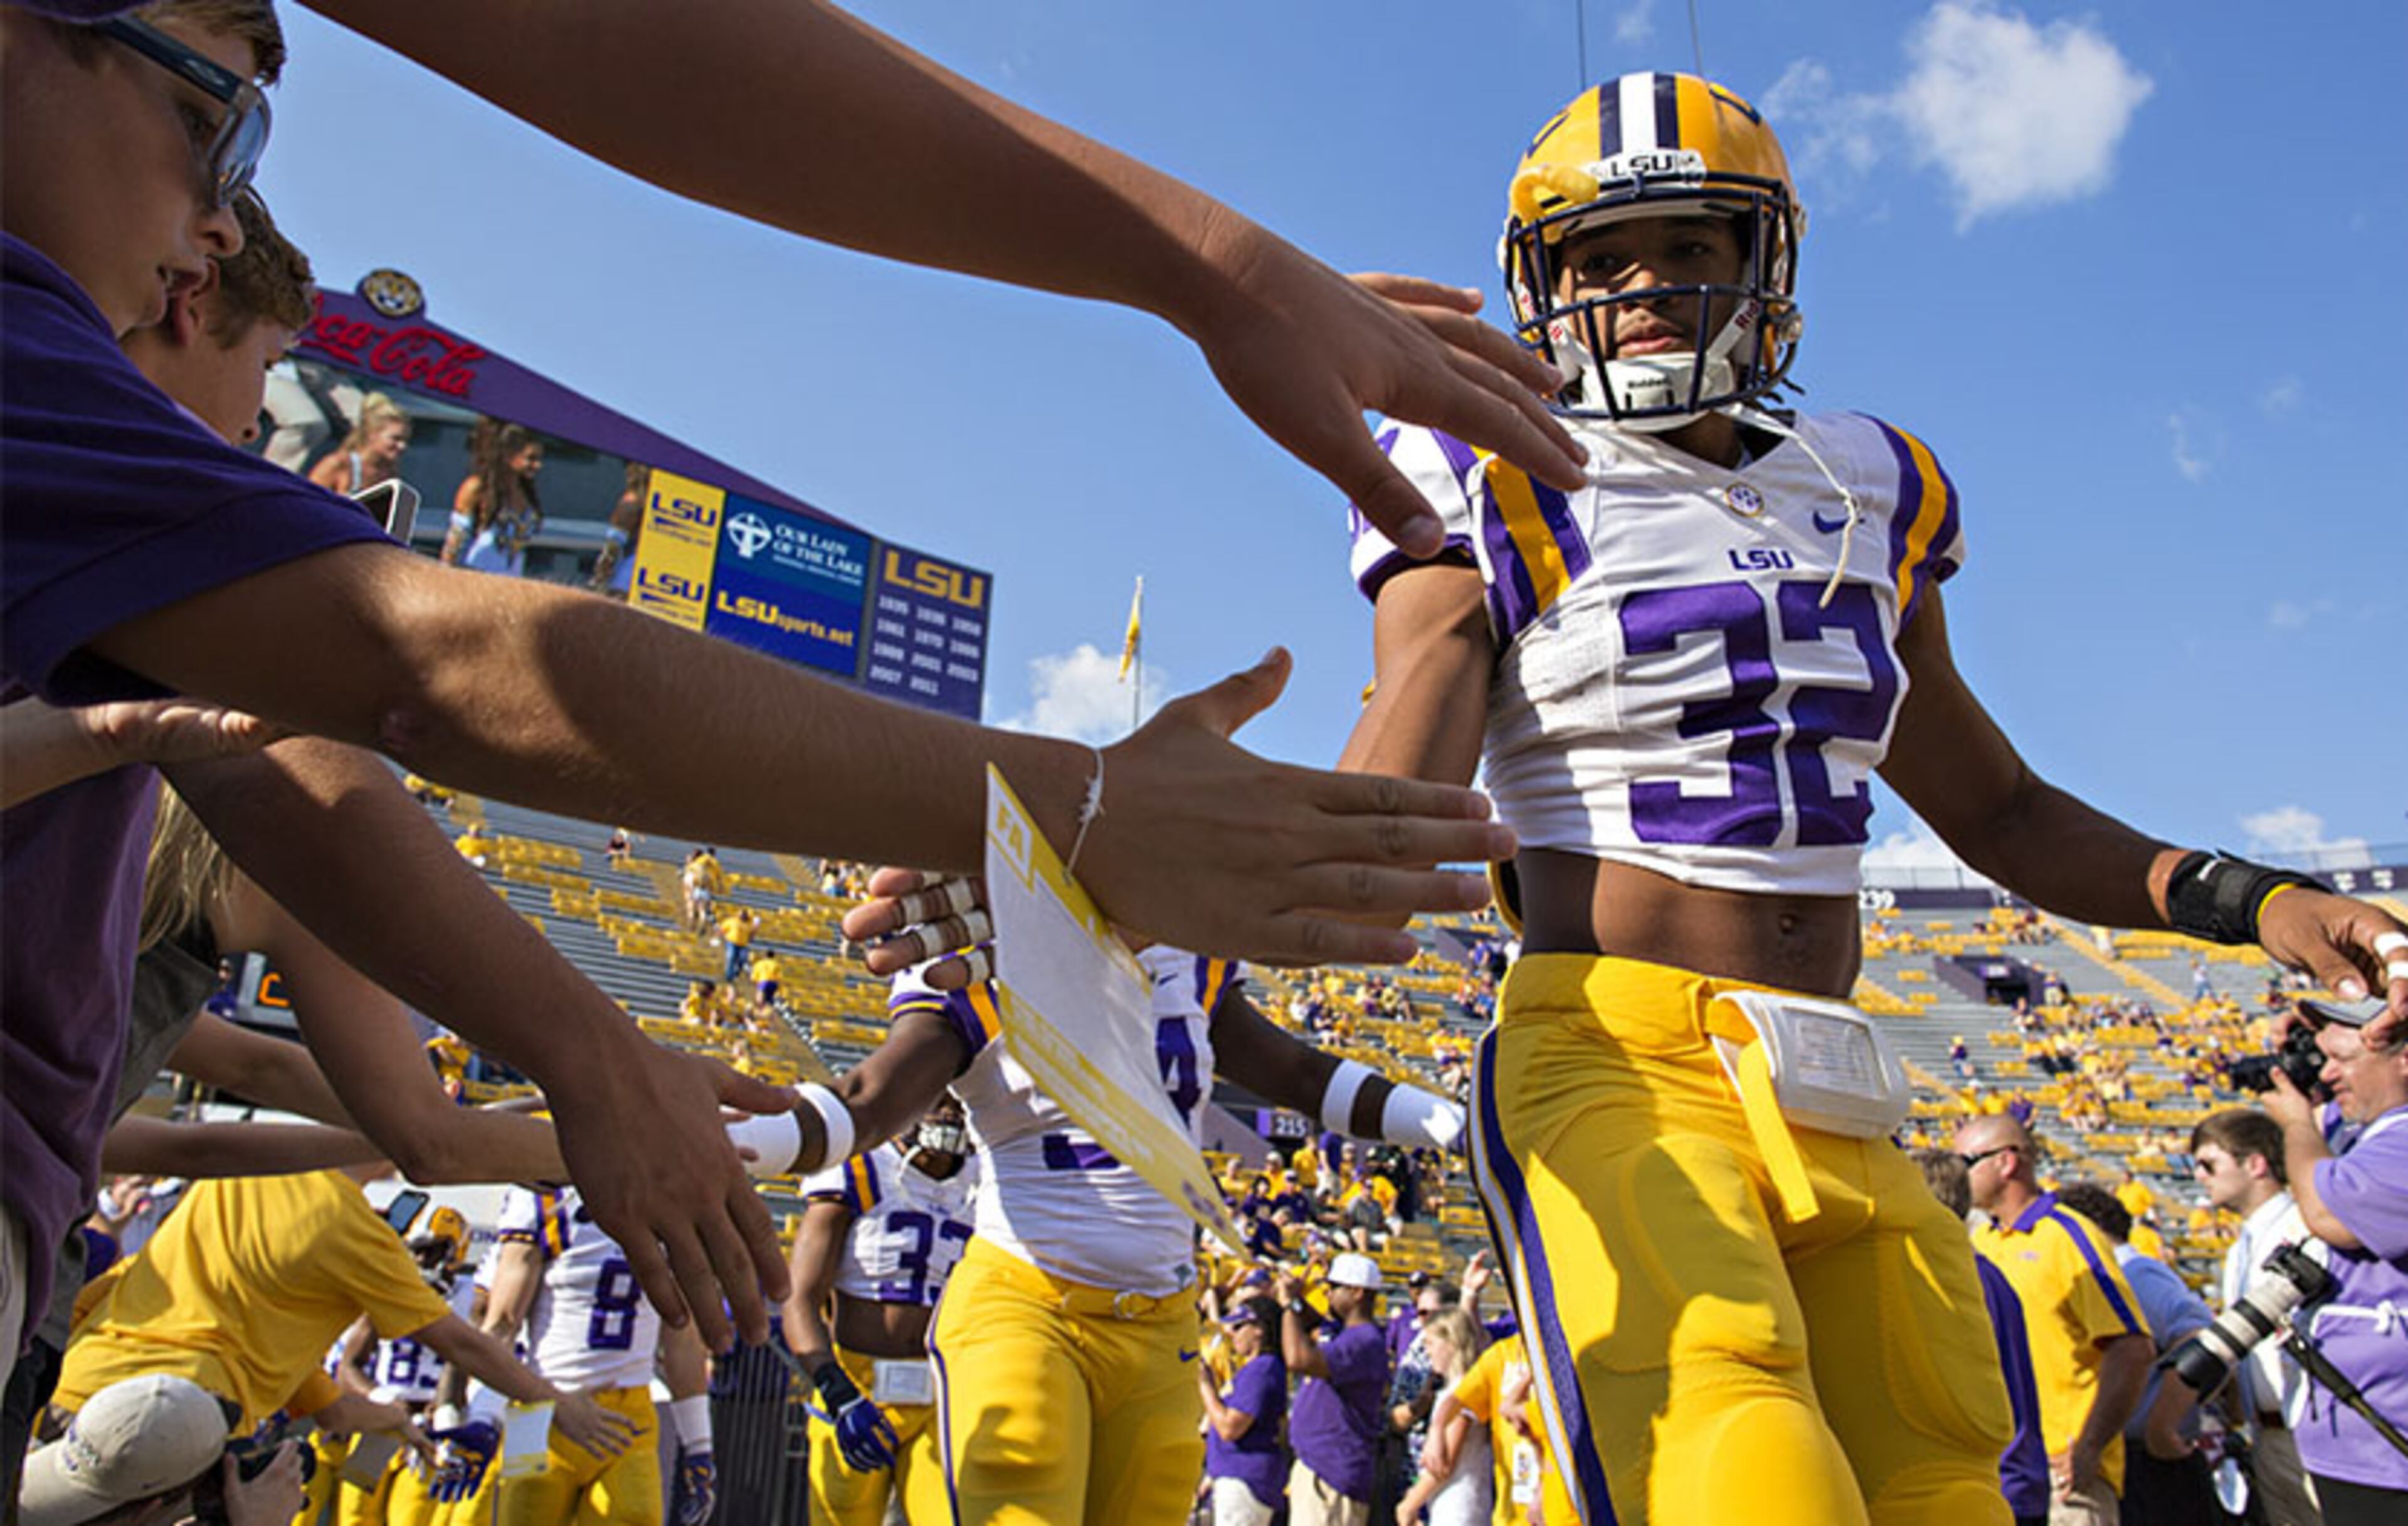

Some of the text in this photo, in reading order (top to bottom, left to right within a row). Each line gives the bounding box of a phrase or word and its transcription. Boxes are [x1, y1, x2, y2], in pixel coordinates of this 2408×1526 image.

[1610, 154, 1672, 176] LSU
[652, 492, 717, 526] LSU
[1728, 549, 1794, 571] LSU
[638, 567, 704, 601] LSU
[884, 549, 983, 608] LSU
[1619, 580, 1899, 846] 32
[1275, 1116, 1306, 1138] 215
[588, 1257, 642, 1350] 8
